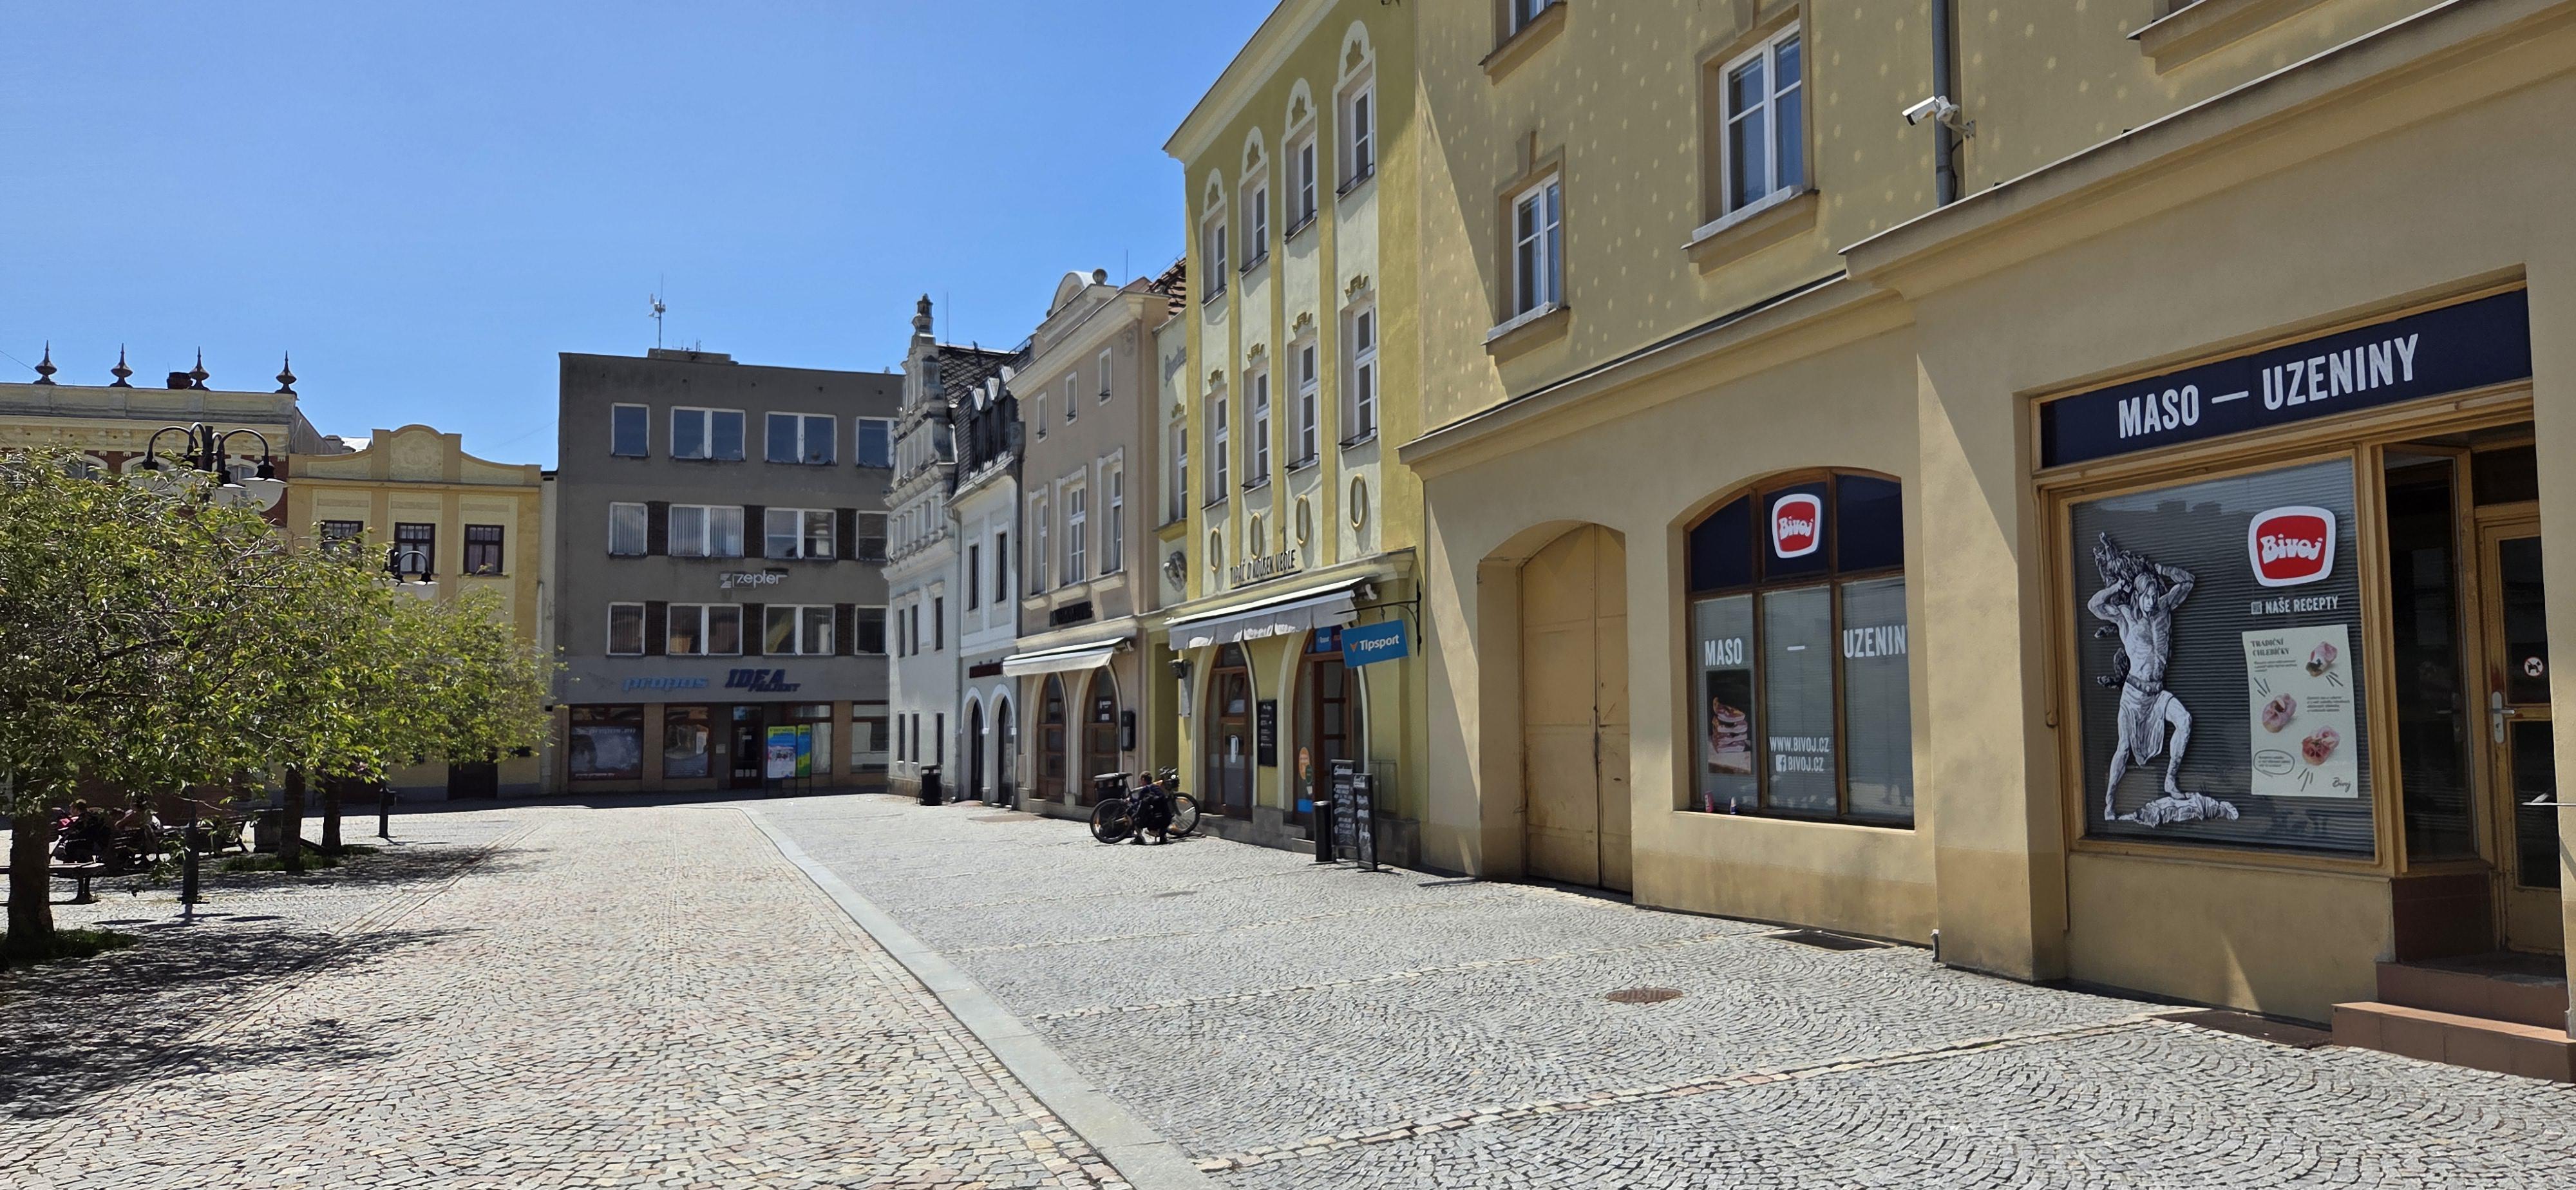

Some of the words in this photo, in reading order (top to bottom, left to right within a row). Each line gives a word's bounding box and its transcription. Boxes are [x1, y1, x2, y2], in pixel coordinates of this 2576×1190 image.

[2118, 384, 2200, 439] MASO
[2262, 333, 2420, 411] UZENINY
[1779, 516, 1814, 540] Bivoj
[2260, 533, 2324, 564] Bivoj
[732, 569, 788, 589] zepter
[2266, 596, 2291, 614] NAŠE
[2293, 595, 2339, 612] RECEPTY
[1359, 634, 1400, 652] Tipsport
[1705, 638, 1742, 666] MASO
[1843, 624, 1908, 658] UZENIN
[621, 677, 708, 692] propos
[724, 668, 786, 688] IDEA
[1769, 736, 1830, 753] WWW.BIVOJ.CZ
[1788, 756, 1824, 772] BIVOJ.CZ
